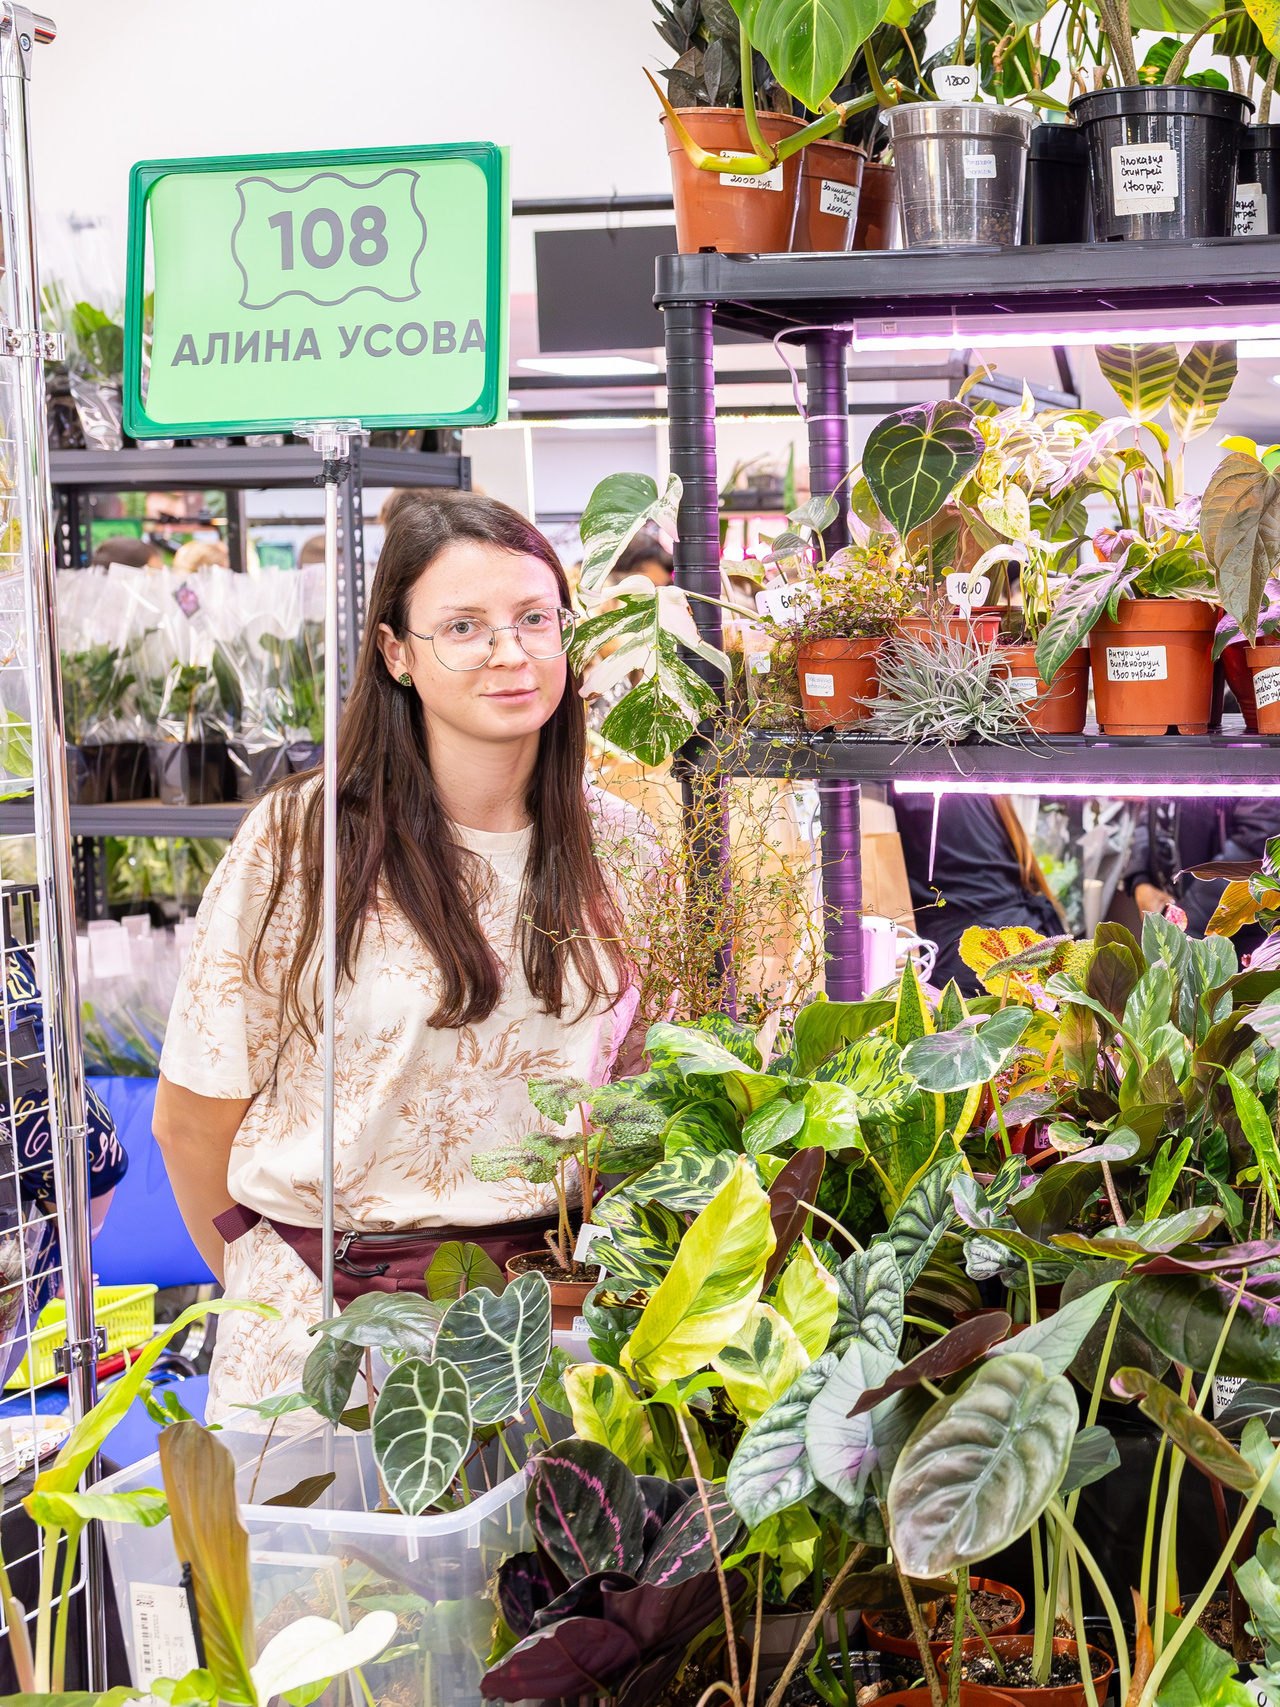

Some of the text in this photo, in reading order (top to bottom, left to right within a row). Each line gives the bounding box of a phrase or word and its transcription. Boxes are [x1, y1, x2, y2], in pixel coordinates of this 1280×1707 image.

[1120, 155, 1163, 166] Алоказия
[730, 174, 756, 184] 2000
[1123, 180, 1145, 192] 1700
[267, 205, 389, 271] 108
[170, 318, 486, 367] АЛИНА УСОВА
